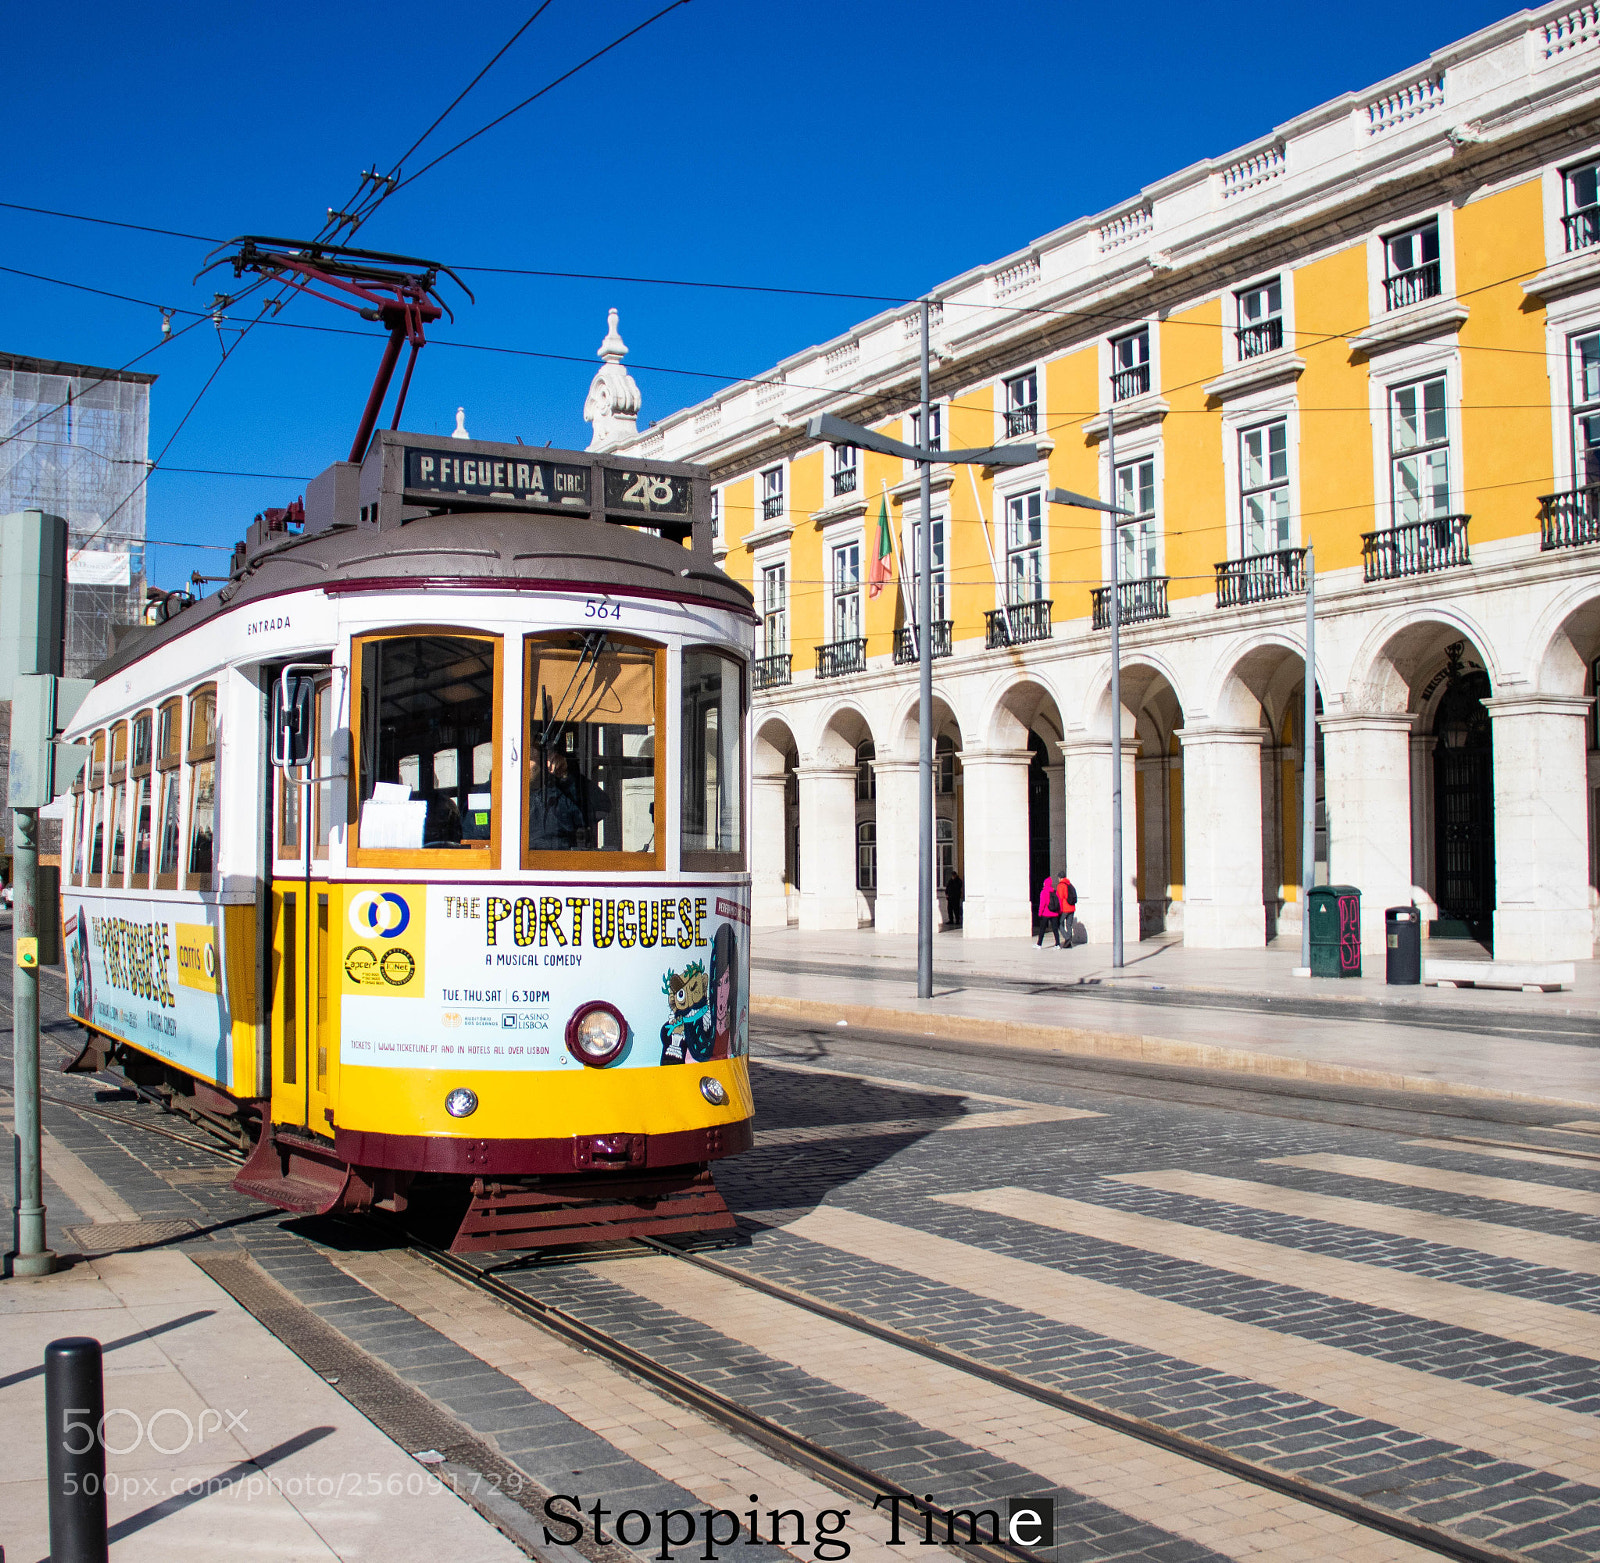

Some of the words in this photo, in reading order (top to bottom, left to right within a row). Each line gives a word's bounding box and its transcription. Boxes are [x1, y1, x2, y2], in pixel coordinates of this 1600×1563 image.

[622, 473, 673, 505] 28
[585, 599, 621, 620] 564
[247, 616, 291, 636] ENTRADA
[444, 896, 480, 919] THE
[486, 896, 707, 950] PORTUGUESE
[350, 960, 372, 971] apcer
[485, 954, 492, 966] A
[496, 954, 539, 966] MUSICAL
[543, 954, 582, 967] COMEDY
[511, 990, 550, 1002] 6.30PM
[518, 1012, 550, 1021] CASINO
[518, 1021, 549, 1030] LISBOA
[351, 1040, 371, 1050] TICKETS
[378, 1042, 438, 1054] WWW.TICKETLINE.PT
[441, 1045, 455, 1054] AND
[457, 1045, 465, 1054] IN
[467, 1045, 491, 1055] HOTELS
[493, 1046, 505, 1055] ALL
[508, 1046, 524, 1055] OVER
[526, 1046, 550, 1055] LISBON
